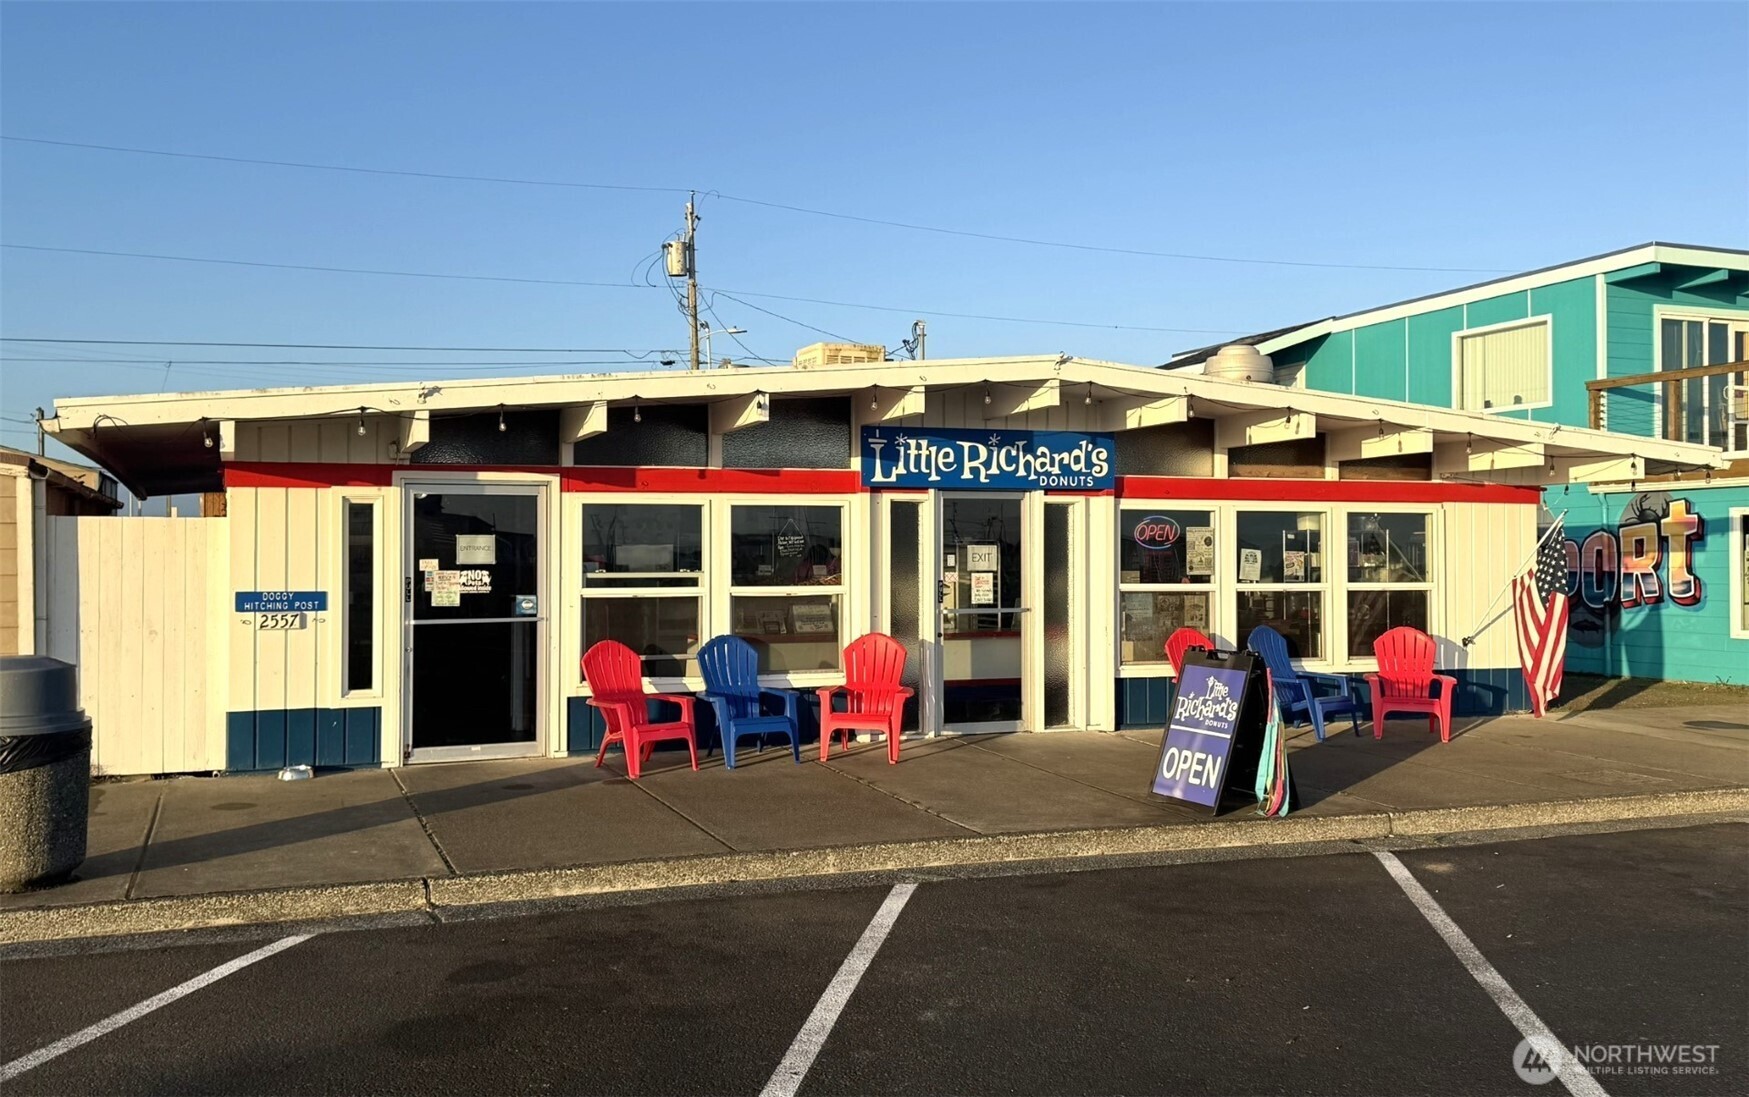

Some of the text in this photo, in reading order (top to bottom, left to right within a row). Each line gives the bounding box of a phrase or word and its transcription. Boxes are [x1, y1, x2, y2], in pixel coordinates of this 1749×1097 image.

[868, 428, 1109, 483] Little Richard's
[1039, 476, 1094, 487] DONUTS
[1135, 524, 1176, 540] OPEN
[971, 552, 993, 562] EXIT
[467, 569, 482, 580] NO
[262, 592, 294, 601] DOGGY
[244, 601, 319, 610] HITCHING POST
[260, 613, 299, 629] 2557
[1205, 675, 1228, 700] Little
[1174, 692, 1238, 722] Richard's
[1205, 720, 1228, 729] DONUTS
[1162, 747, 1222, 789] OPEN
